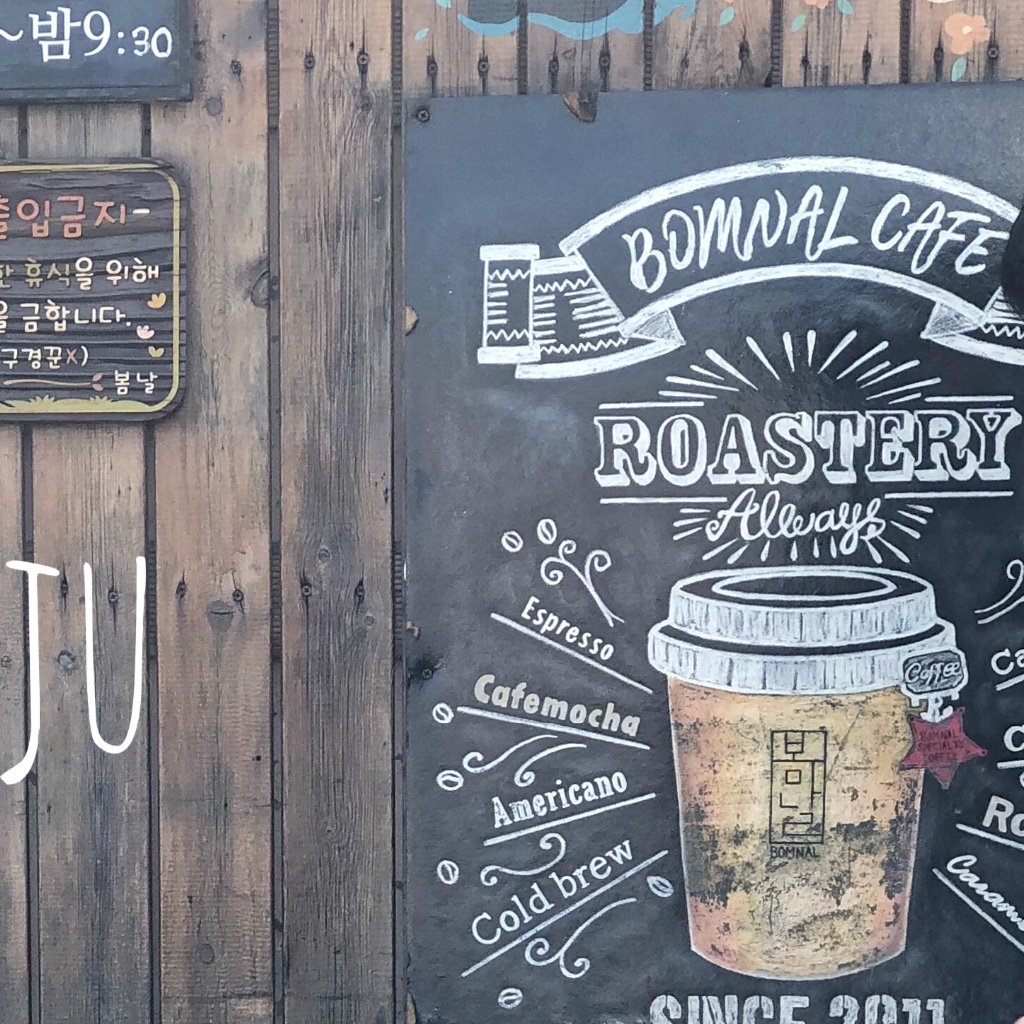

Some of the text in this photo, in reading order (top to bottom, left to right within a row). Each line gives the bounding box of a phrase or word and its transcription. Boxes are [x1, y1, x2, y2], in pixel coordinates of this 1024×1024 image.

[622, 184, 1010, 294] BOMNAL CAFE
[24, 256, 94, 291] 휴식을
[105, 257, 159, 285] 위해
[20, 300, 131, 333] 금합니다.
[593, 407, 1023, 488] ROASTERY
[521, 596, 615, 661] Espresso
[474, 674, 641, 737] Cafemocha
[492, 771, 628, 829] Americano
[770, 846, 819, 860] BOMNAL
[471, 840, 635, 945] Cold brew
